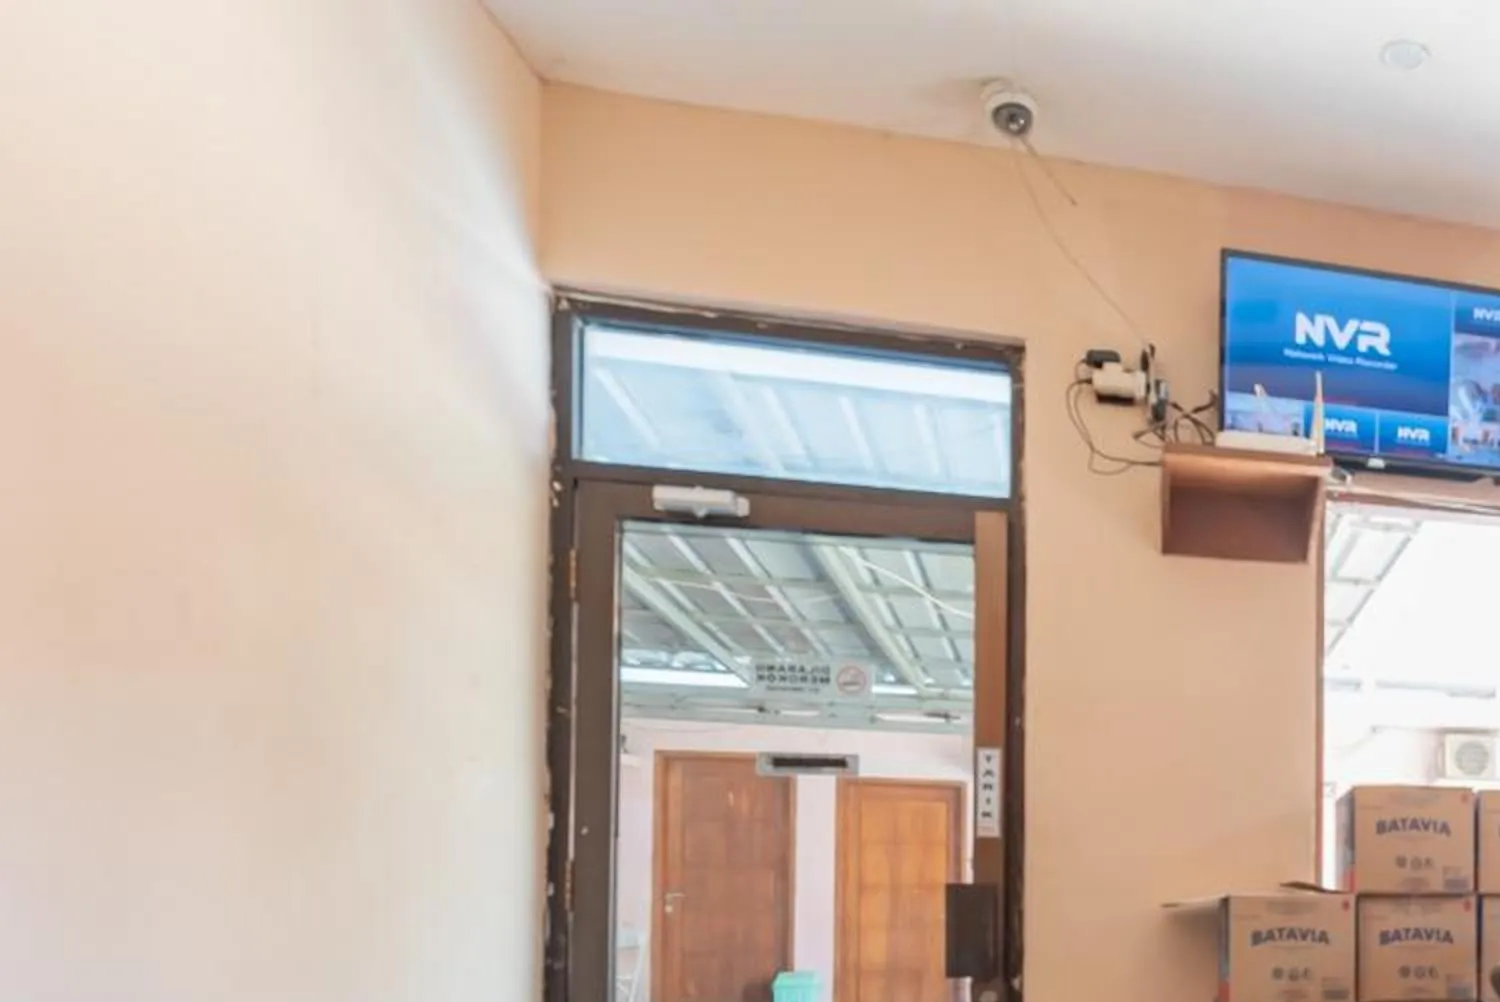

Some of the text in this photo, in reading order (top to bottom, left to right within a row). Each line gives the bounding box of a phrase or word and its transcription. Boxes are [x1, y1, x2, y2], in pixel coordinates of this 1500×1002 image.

[1295, 311, 1391, 356] NVR
[1397, 425, 1431, 442] NVR
[1375, 816, 1452, 837] BATAVIA
[1250, 927, 1330, 947] BATAVIA
[1378, 927, 1454, 946] BATAVIA
